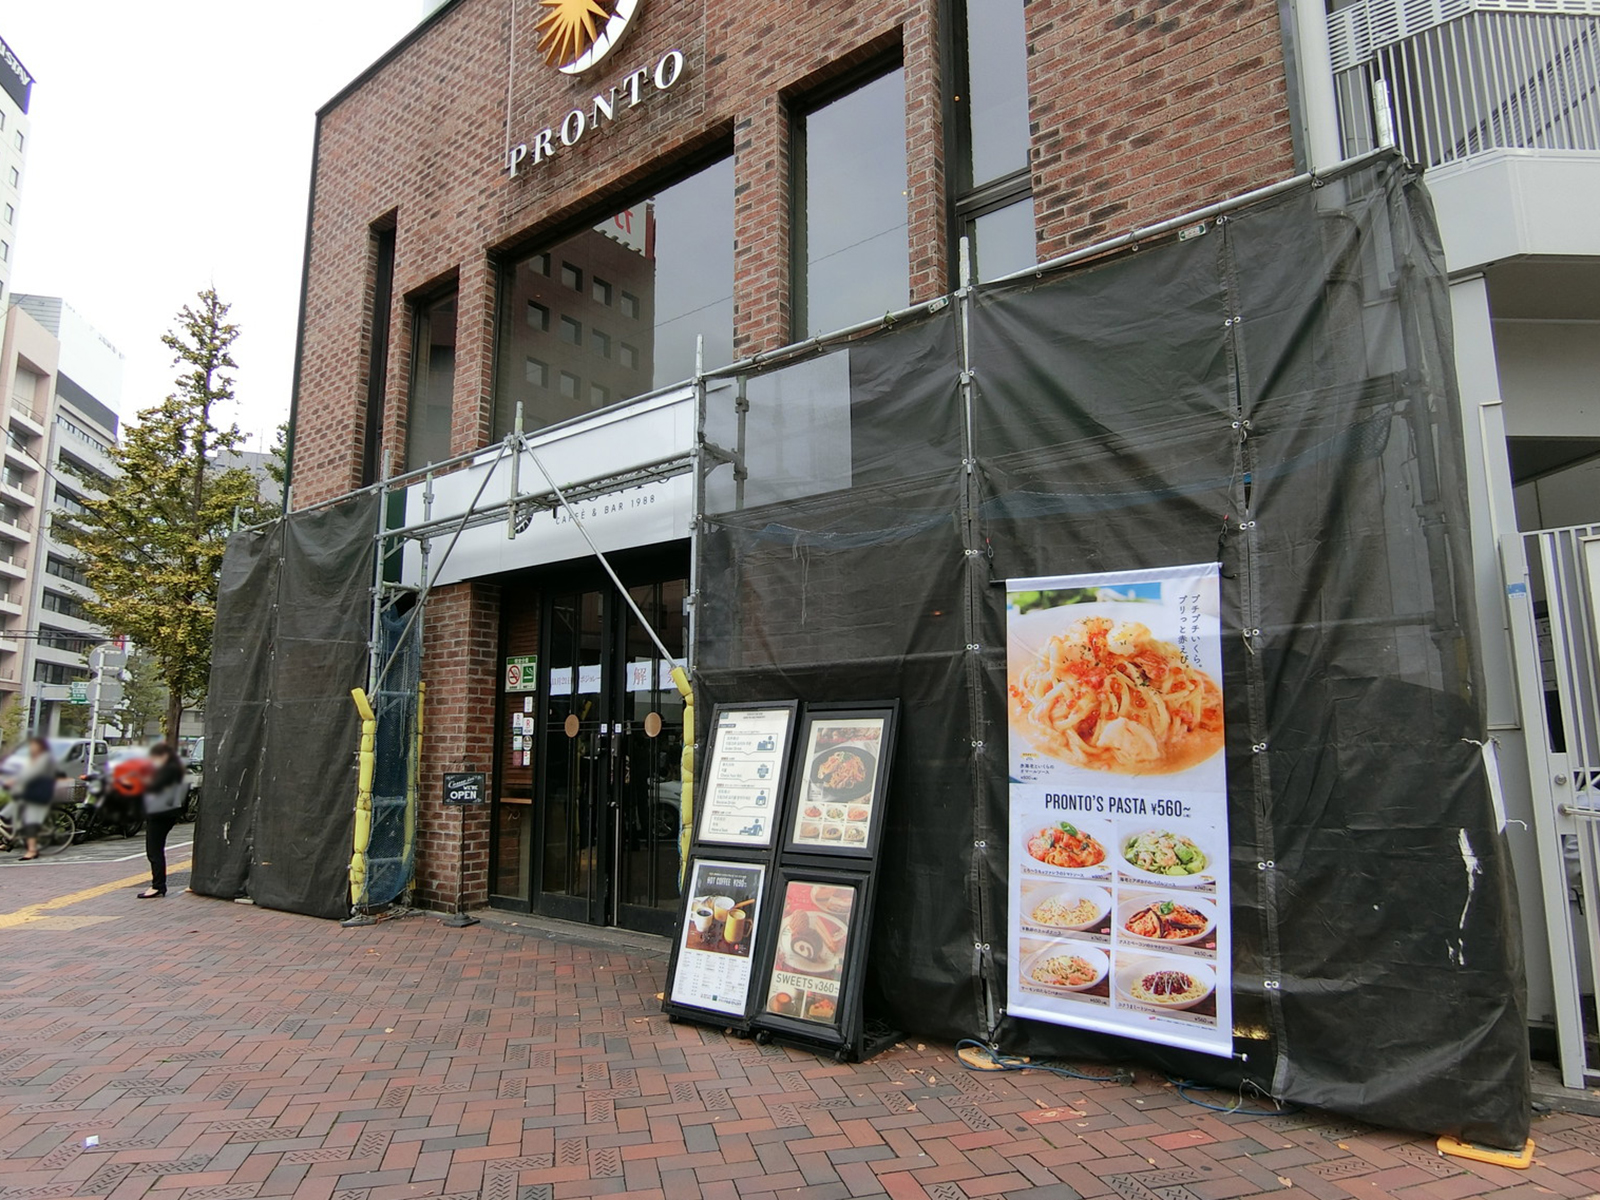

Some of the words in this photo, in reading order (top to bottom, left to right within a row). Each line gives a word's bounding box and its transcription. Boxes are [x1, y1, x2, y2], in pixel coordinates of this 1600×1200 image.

[508, 50, 686, 179] PRONTO
[591, 507, 598, 517] &
[604, 501, 624, 515] BAR
[631, 494, 656, 509] 1988
[450, 790, 477, 800] OPEN
[1045, 793, 1104, 812] PRONTO'S
[1108, 796, 1147, 815] PASTA
[776, 973, 813, 989] SWEETS
